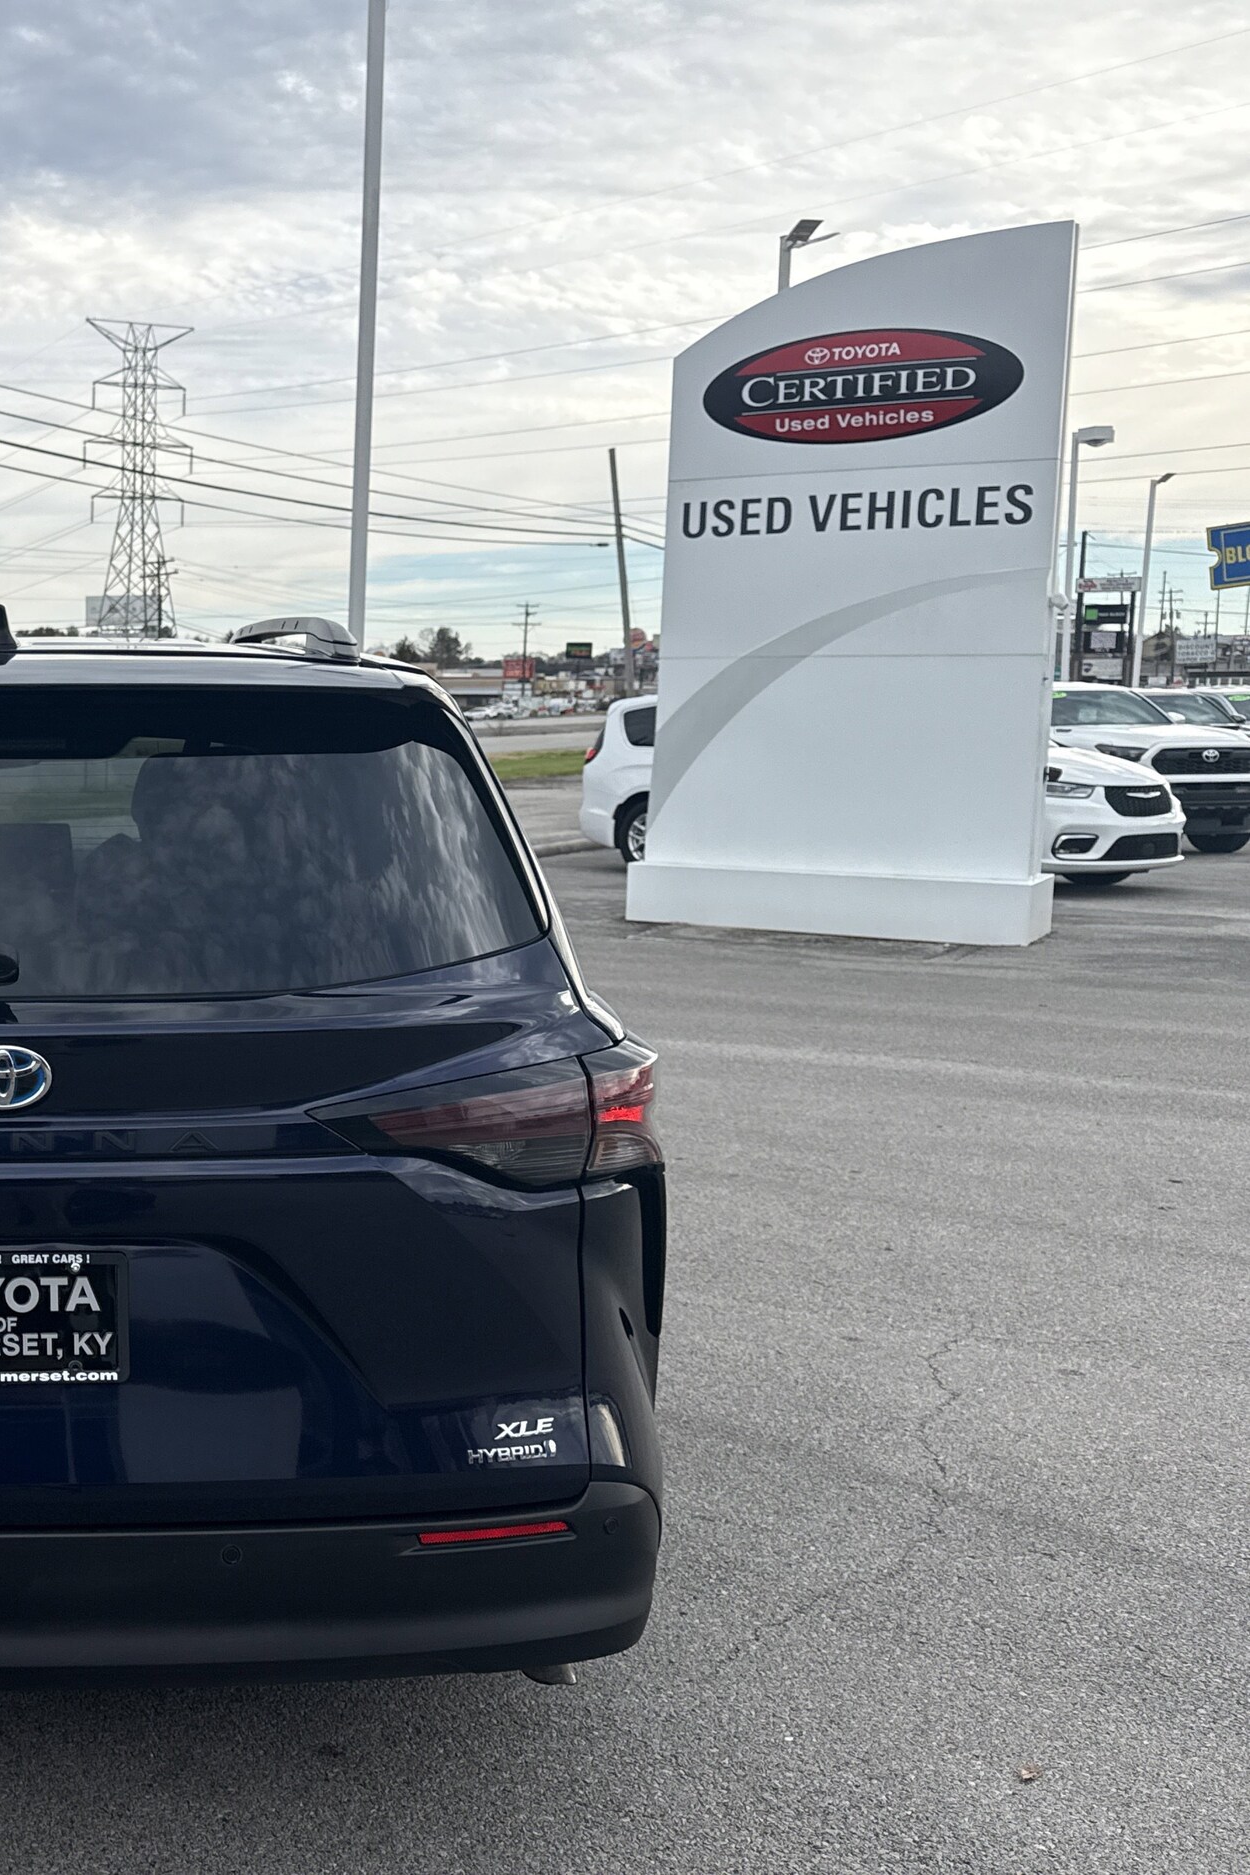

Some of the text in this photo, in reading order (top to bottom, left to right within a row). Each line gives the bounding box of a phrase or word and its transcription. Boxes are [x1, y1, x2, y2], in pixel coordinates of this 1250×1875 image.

[832, 341, 901, 361] TOYOTA
[741, 365, 977, 408] CERTIFIED
[774, 408, 935, 433] Used Vehicles
[682, 483, 1035, 538] USED VEHICLES
[11, 1254, 49, 1264] GREAT
[73, 1332, 113, 1356] KY
[494, 1417, 554, 1440] XLE
[467, 1444, 547, 1464] HYBRID
